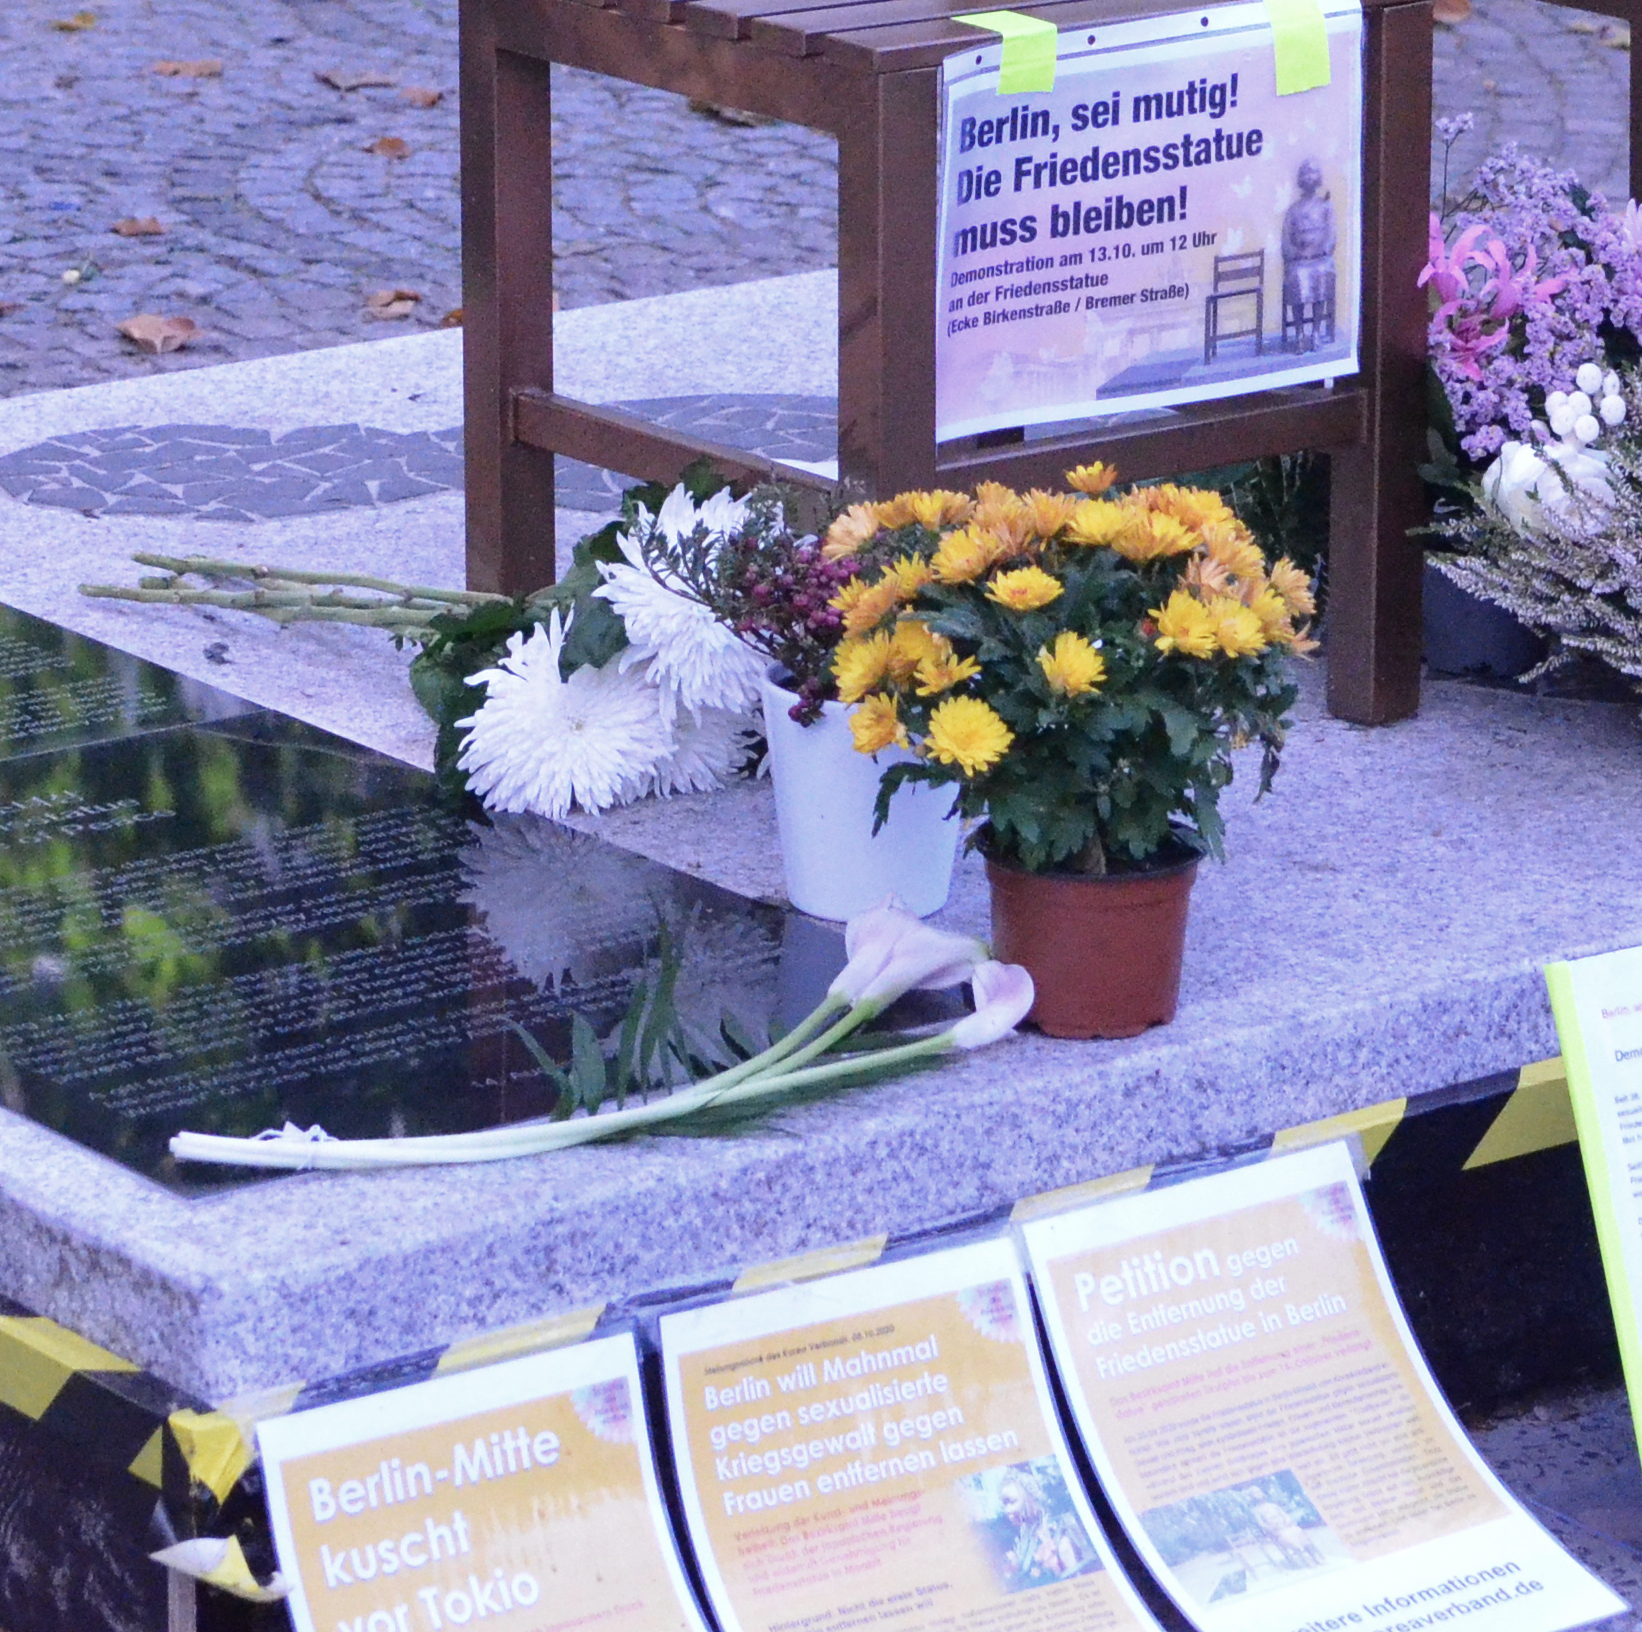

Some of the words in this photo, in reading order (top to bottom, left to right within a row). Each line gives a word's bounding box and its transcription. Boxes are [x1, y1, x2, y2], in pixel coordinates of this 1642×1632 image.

[959, 104, 1060, 153] Berlin,
[1071, 90, 1120, 132] sei
[1132, 73, 1239, 122] mutig!
[957, 165, 1002, 206] Die
[1013, 125, 1264, 193] Friedensstatue
[952, 215, 1037, 257] muss
[1050, 187, 1189, 238] bleiben!
[949, 297, 962, 312] an
[967, 291, 990, 307] der
[995, 273, 1109, 301] Friedensstatue
[951, 255, 1054, 288] Demonstration
[1059, 251, 1083, 267] am
[1089, 243, 1136, 263] 13.10.
[1141, 240, 1164, 256] um
[1170, 235, 1187, 251] 12
[1192, 231, 1217, 249] Uhr
[947, 313, 978, 337] (Ecke
[983, 299, 1070, 326] Birkenstraße
[1074, 297, 1081, 312] /
[1085, 292, 1136, 310] Bremer
[1140, 282, 1189, 303] Straße)
[60, 810, 176, 836] Peace
[1073, 1247, 1221, 1311] Petition
[1226, 1237, 1299, 1279] gegen
[1088, 1320, 1121, 1346] die
[1127, 1286, 1245, 1336] Entfernung
[1250, 1275, 1287, 1302] der
[704, 1378, 771, 1411] Berlin
[778, 1363, 816, 1394] will
[822, 1335, 939, 1384] Mahnmal
[1096, 1320, 1256, 1379] Friedensstatue
[1258, 1312, 1282, 1334] in
[1287, 1293, 1347, 1326] Berlin
[709, 1406, 792, 1451] gegen
[798, 1371, 949, 1425] sexualisierte
[715, 1423, 877, 1481] Kriegsgewalt
[883, 1405, 964, 1449] gegen
[308, 1426, 561, 1523] Berlin-Mitte
[722, 1478, 810, 1518] Frauen
[817, 1449, 936, 1496] entfernen
[940, 1429, 1018, 1466] lassen
[319, 1510, 471, 1589] kuscht
[337, 1603, 409, 1632] vor
[417, 1567, 540, 1631] Tokio
[1291, 1610, 1362, 1632] itere
[1362, 1560, 1521, 1618] Informationen
[1373, 1578, 1544, 1632] reaverband.de
